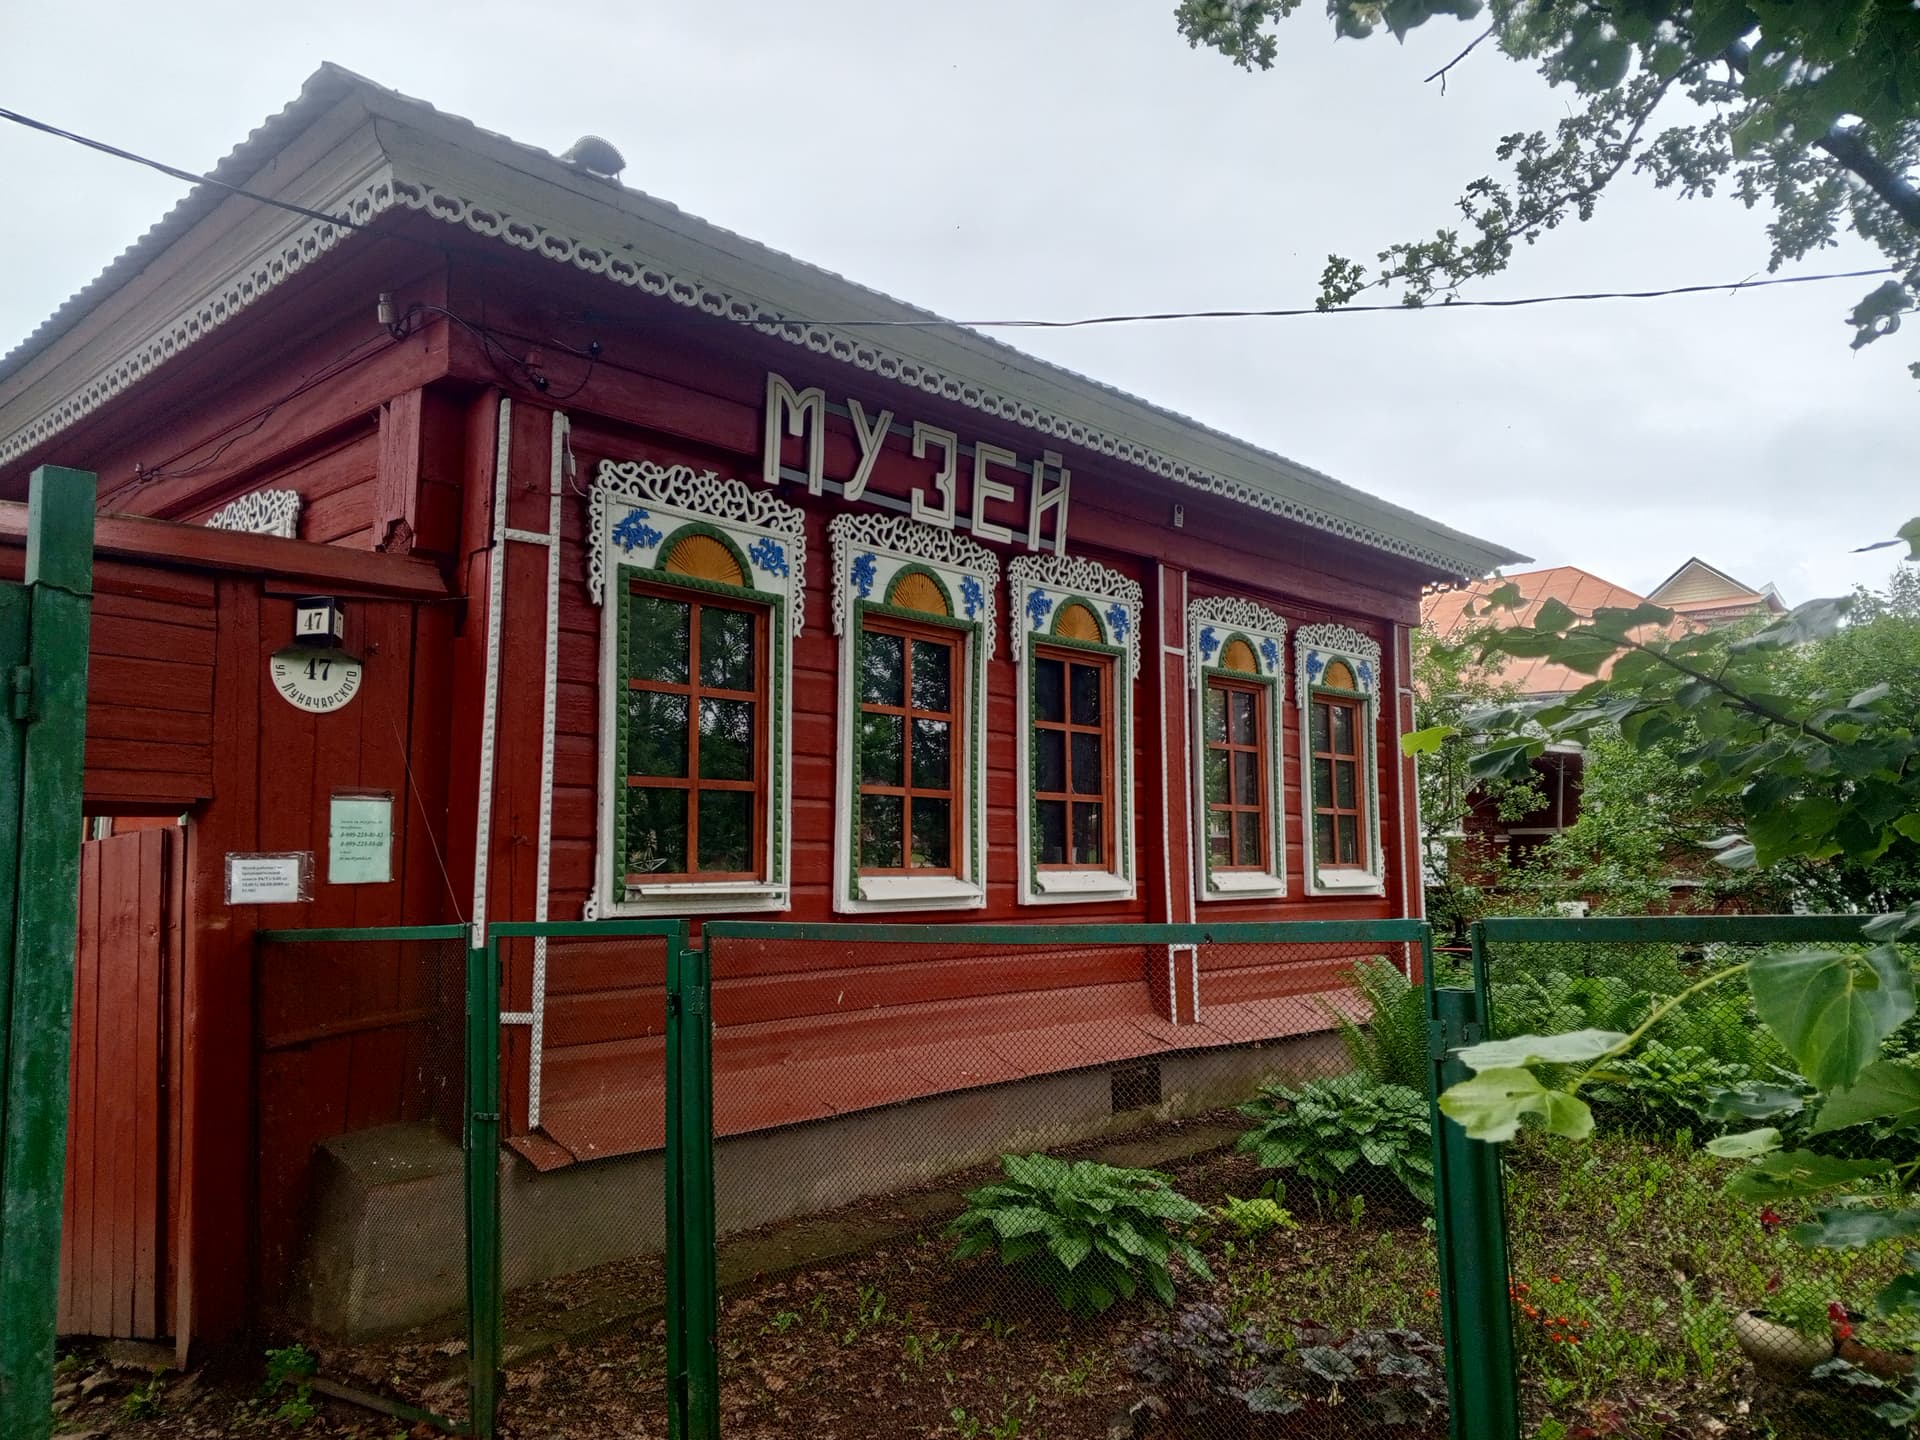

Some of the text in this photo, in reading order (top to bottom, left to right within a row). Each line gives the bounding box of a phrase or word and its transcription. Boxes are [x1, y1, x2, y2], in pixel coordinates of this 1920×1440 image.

[763, 372, 1071, 557] МУЗЕЙ
[304, 612, 323, 631] 47
[303, 657, 332, 682] 47
[281, 670, 358, 709] ЛУНАЧАРСКОГО
